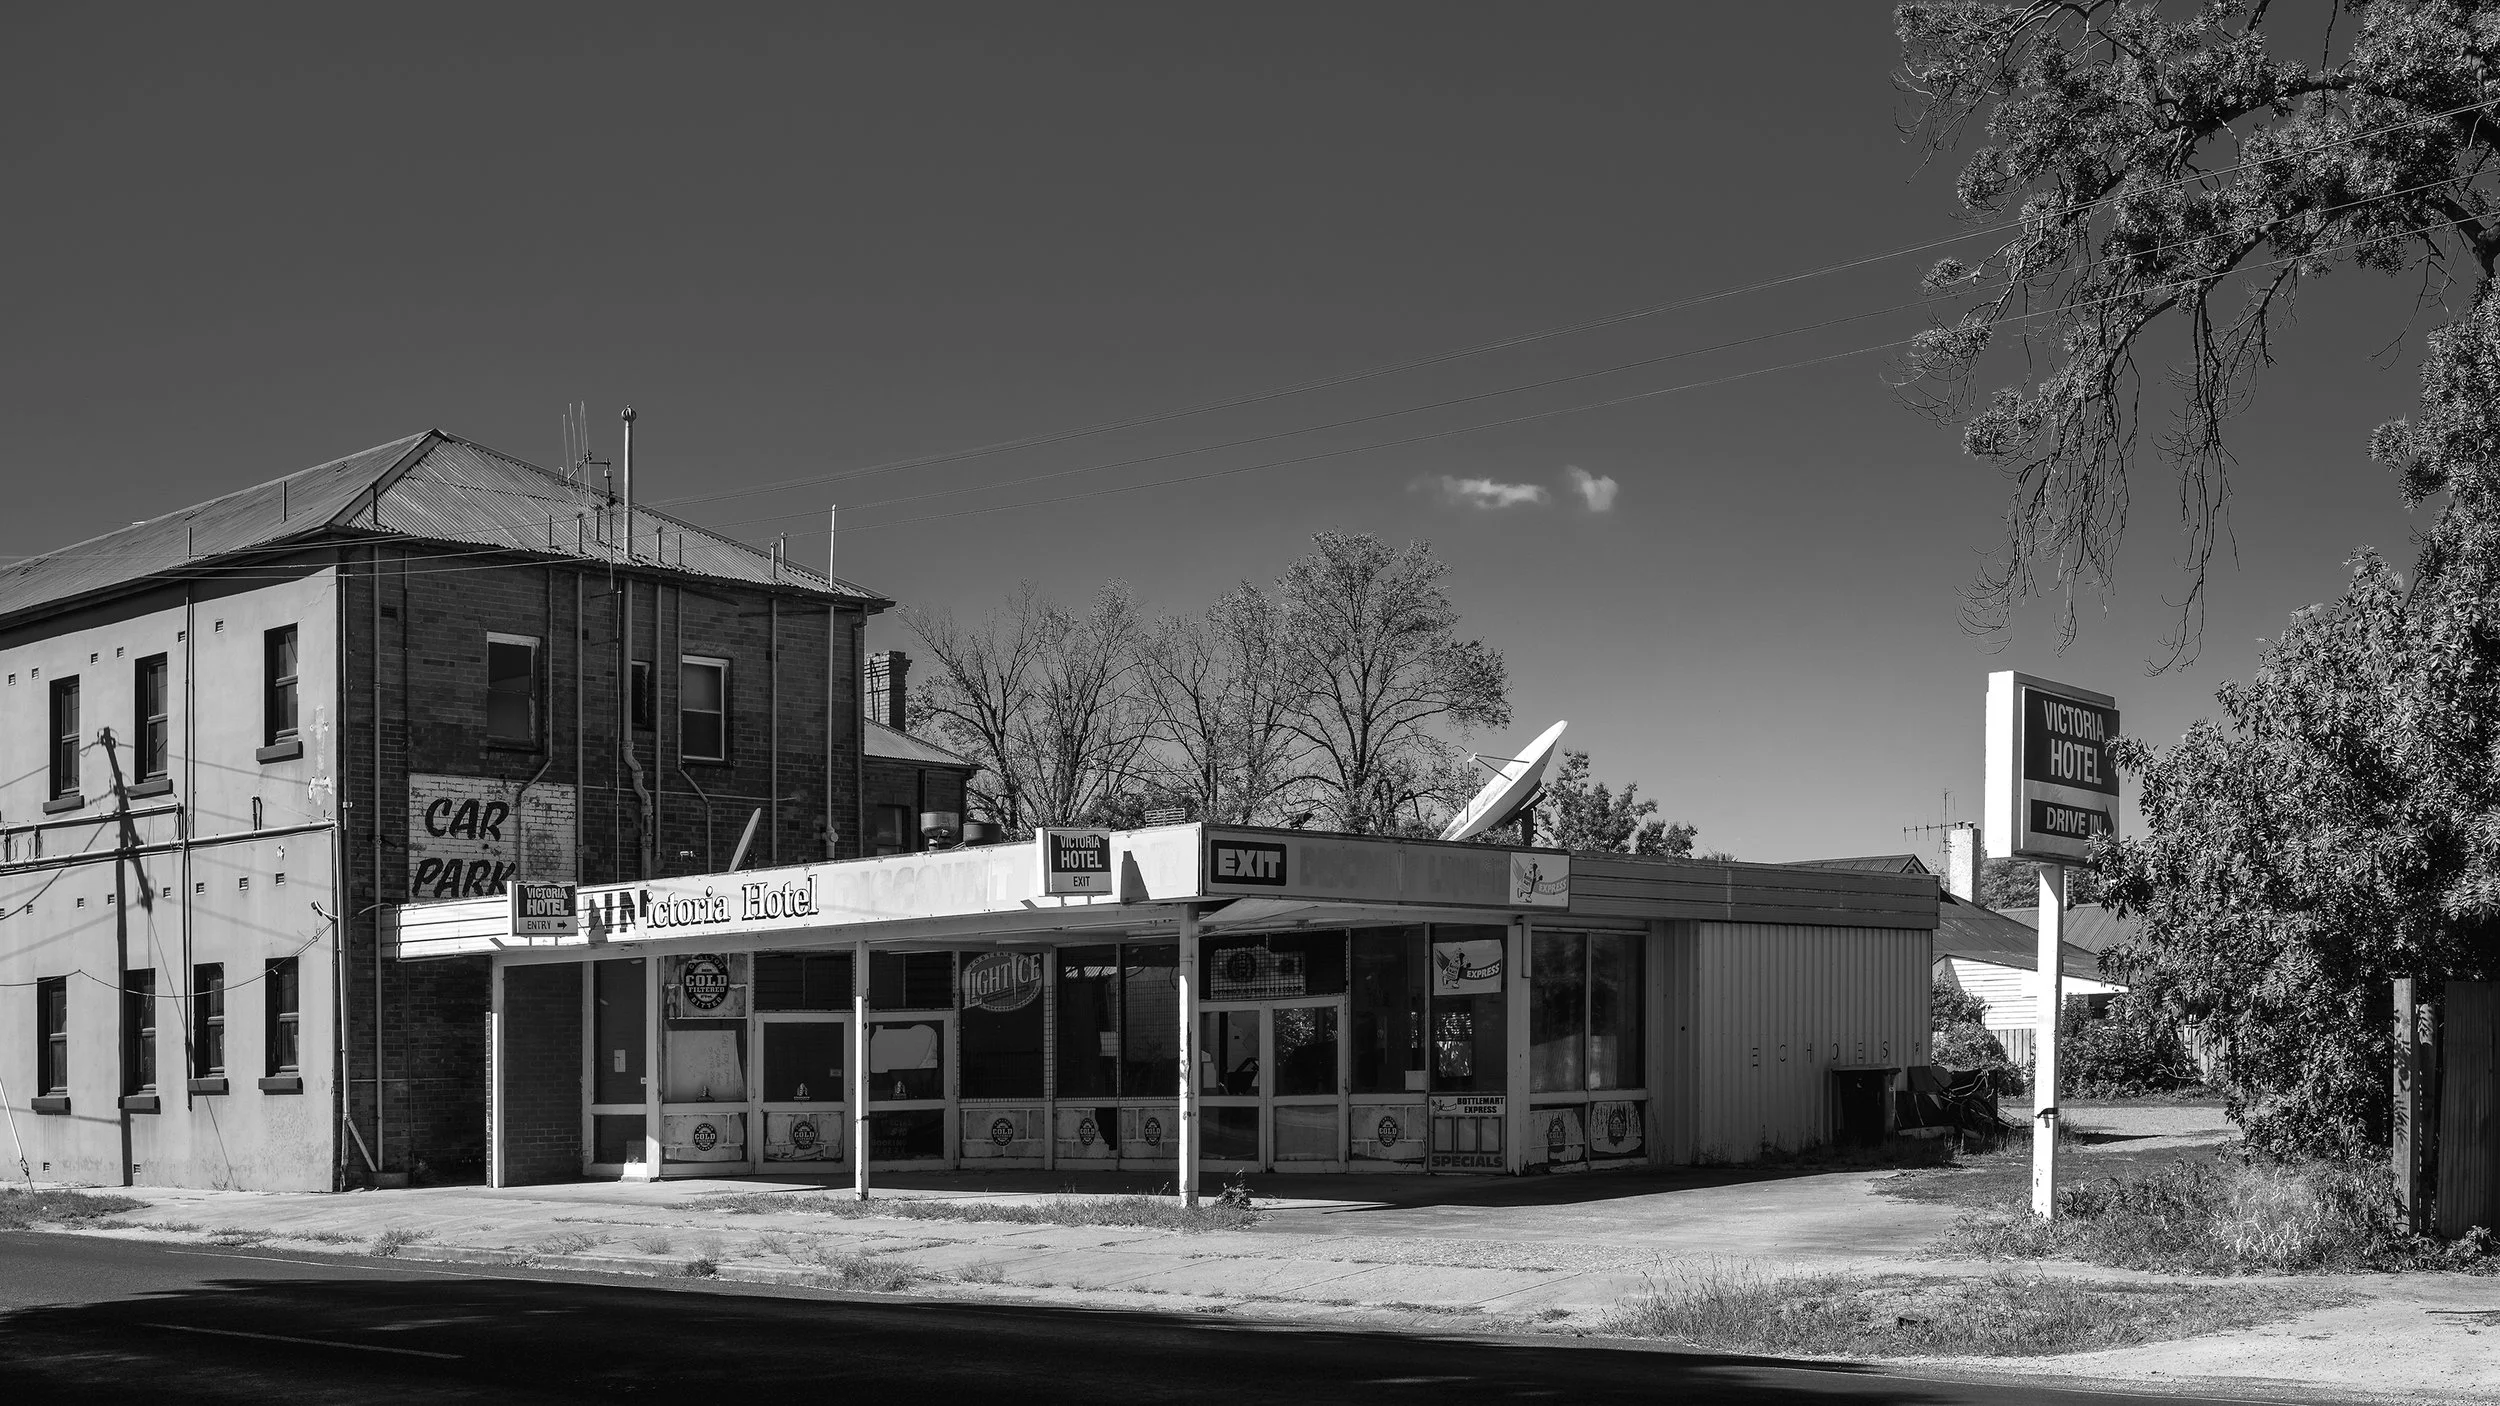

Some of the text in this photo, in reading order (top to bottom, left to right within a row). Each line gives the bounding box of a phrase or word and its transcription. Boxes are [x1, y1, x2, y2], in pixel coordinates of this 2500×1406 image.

[2043, 700, 2105, 742] VICTORIA
[2051, 738, 2102, 785] HOTEL
[425, 797, 510, 841] CAR
[2046, 807, 2103, 837] DRIVE IN
[1060, 836, 1100, 848] VICTORIA
[1061, 850, 1102, 868] HOTEL
[1217, 848, 1280, 878] EXIT
[412, 857, 516, 898] PARK
[1073, 876, 1090, 887] EXIT
[527, 887, 568, 899] VICTORIA
[1538, 879, 1567, 893] EXPRESS
[527, 899, 569, 916] HOTEL
[646, 886, 731, 929] ictoria
[742, 874, 819, 922] Hotel
[528, 921, 551, 930] ENTRY
[1466, 963, 1500, 979] EXPRESS
[685, 975, 728, 987] COLD
[961, 962, 1011, 1010] LIGHT
[1010, 953, 1041, 1002] ICE
[1457, 1097, 1505, 1105] BOTTLEMART
[1464, 1106, 1498, 1114] EXPRESS
[1379, 1127, 1397, 1135] COLD
[1431, 1156, 1504, 1168] SPECIALS
